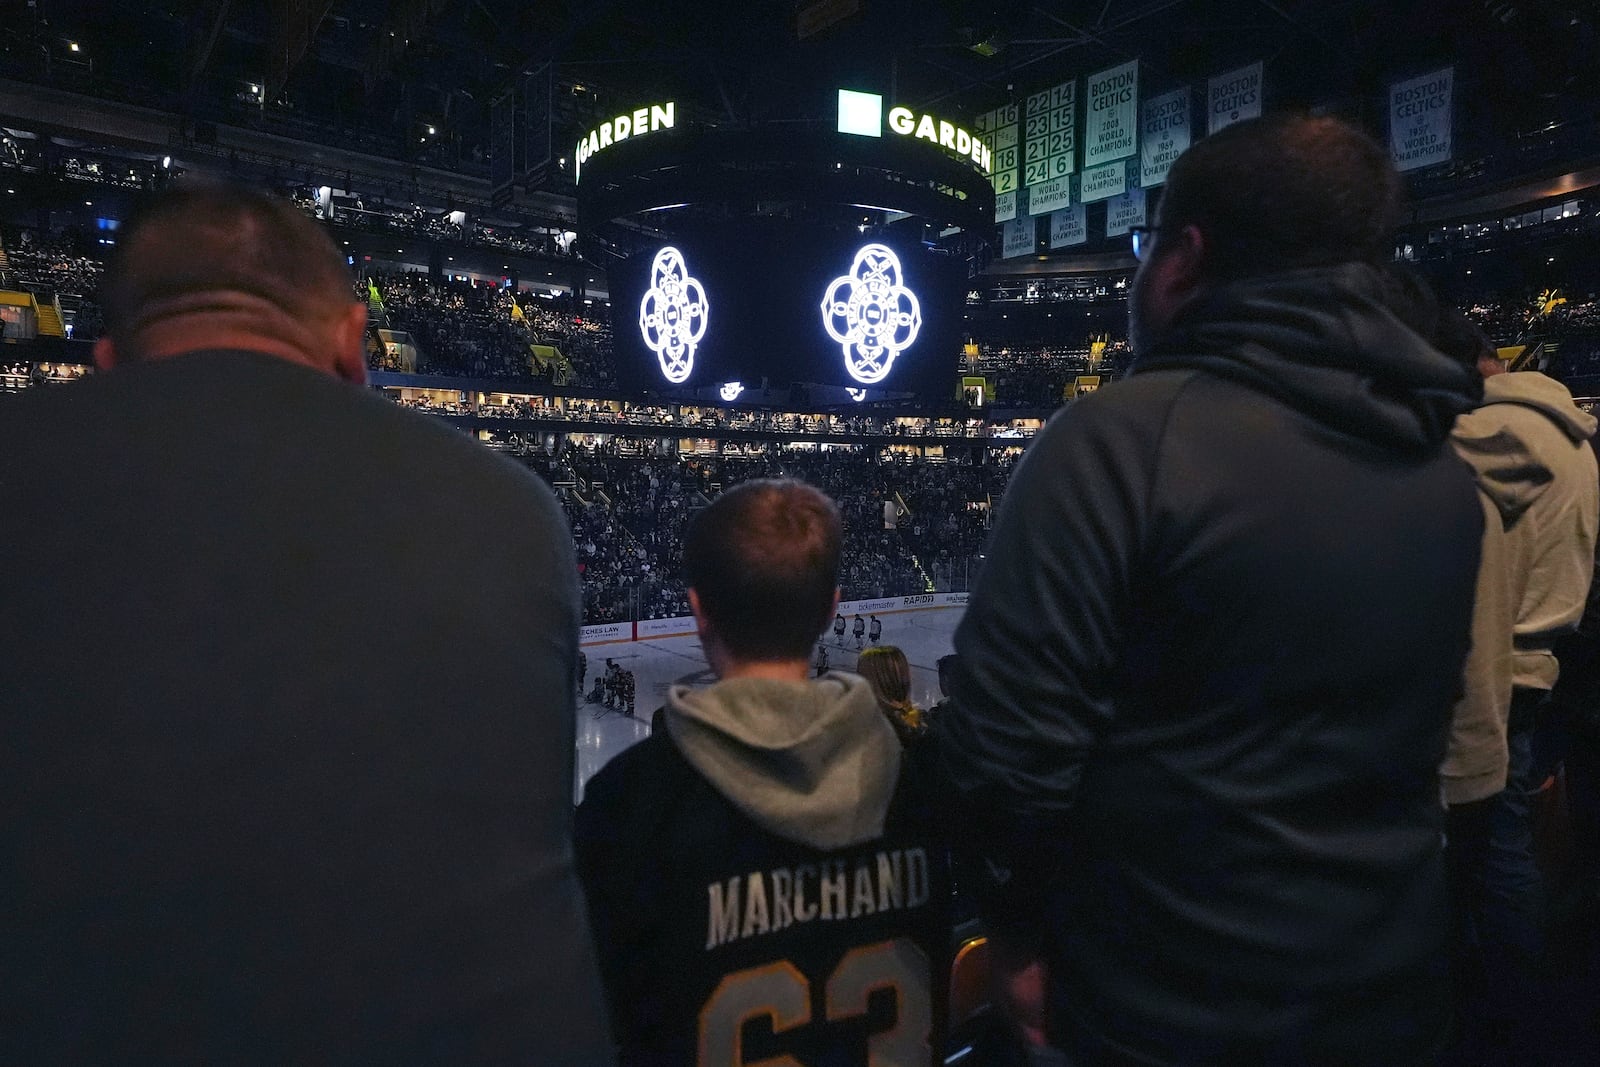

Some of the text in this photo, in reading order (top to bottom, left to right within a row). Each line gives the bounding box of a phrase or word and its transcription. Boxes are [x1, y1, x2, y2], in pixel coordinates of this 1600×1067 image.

[1091, 70, 1134, 97] BOSTON
[1212, 73, 1258, 100] BOSTON
[1394, 78, 1448, 105] BOSTON
[1028, 83, 1073, 115] 22 14
[1093, 87, 1132, 112] CELTICS
[1145, 97, 1186, 120] BOSTON
[1215, 88, 1257, 114] CELTICS
[1397, 94, 1445, 119] CELTICS
[1000, 106, 1016, 125] 16
[1027, 107, 1072, 138] 23 15
[1146, 112, 1185, 134] CELTICS
[580, 101, 675, 164] GARDEN
[888, 106, 992, 173] GARDEN
[1098, 128, 1124, 143] WORLD
[1404, 134, 1437, 150] WORLD
[1028, 130, 1072, 160] 21 25
[1090, 136, 1132, 156] CHAMPIONS
[1394, 141, 1448, 162] CHAMPIONS
[998, 149, 1015, 169] 18
[1153, 149, 1179, 165] WORLD
[1026, 156, 1067, 184] 24 6
[1092, 168, 1116, 182] WORLD
[1144, 163, 1170, 177] CHAMP
[1001, 173, 1012, 191] 2
[1038, 183, 1060, 195] WORLD
[1083, 176, 1123, 193] CHAMPIONS
[1032, 190, 1067, 206] CHAMPIONS
[706, 848, 931, 951] MARCHAND
[697, 937, 933, 1067] 63
